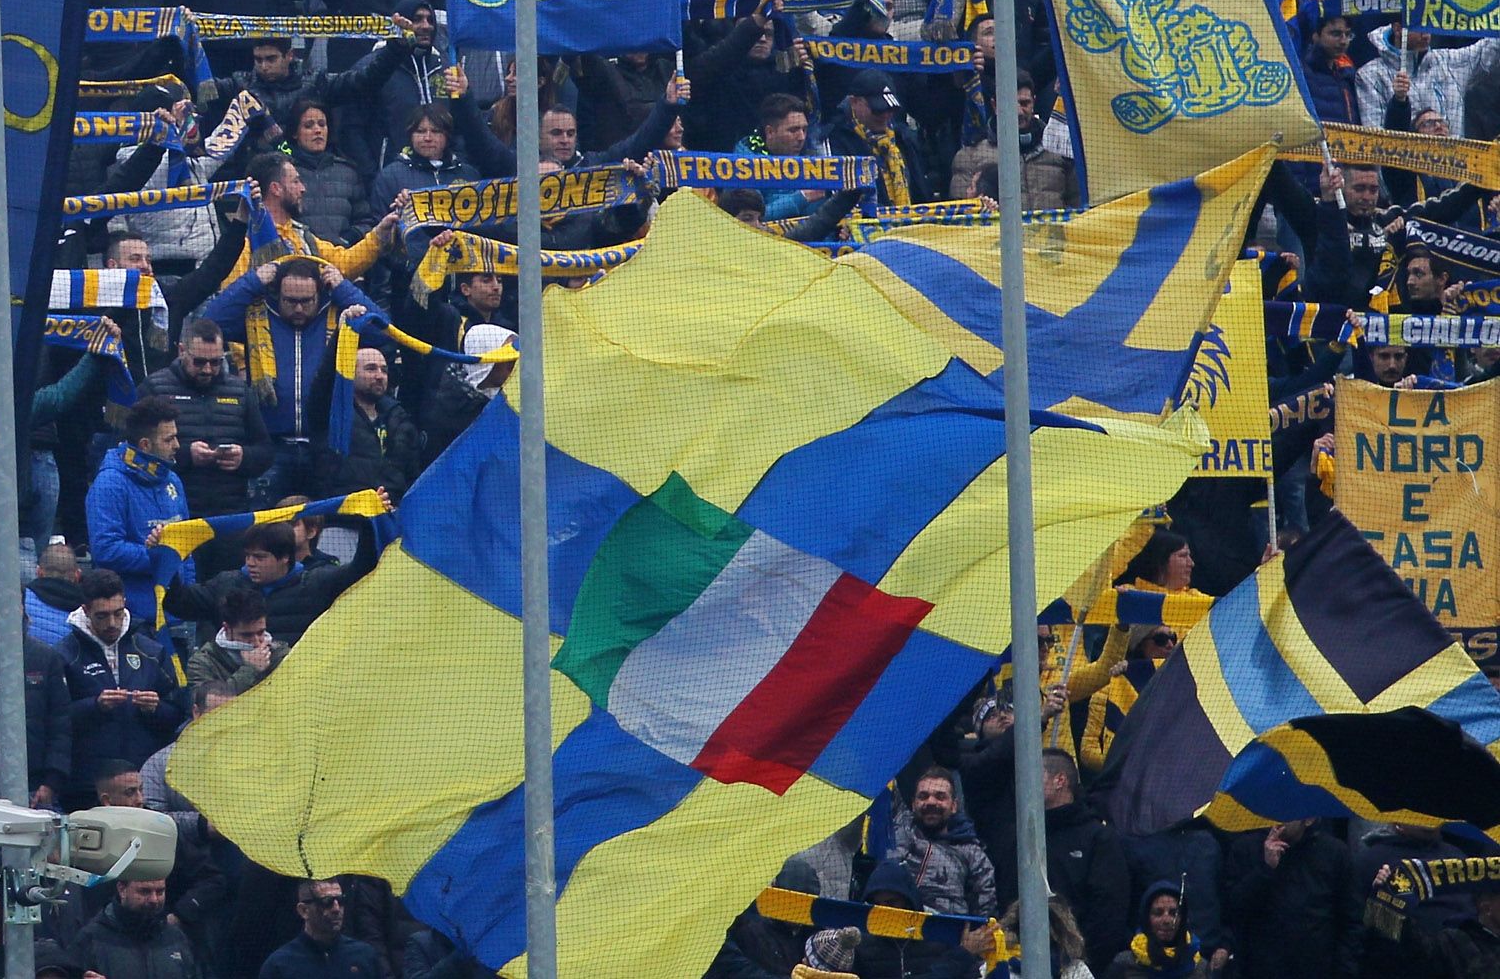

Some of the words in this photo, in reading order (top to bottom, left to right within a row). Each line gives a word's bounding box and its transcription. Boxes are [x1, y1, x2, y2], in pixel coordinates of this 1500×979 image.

[811, 41, 908, 65] IOCIARI
[679, 156, 839, 181] FROSINONE
[64, 183, 206, 215] OSINONE
[411, 169, 611, 224] FROSIONE
[45, 316, 95, 341] 00%
[1402, 316, 1500, 346] GIALLO
[1388, 390, 1450, 427] LA
[1356, 434, 1485, 473] NORD
